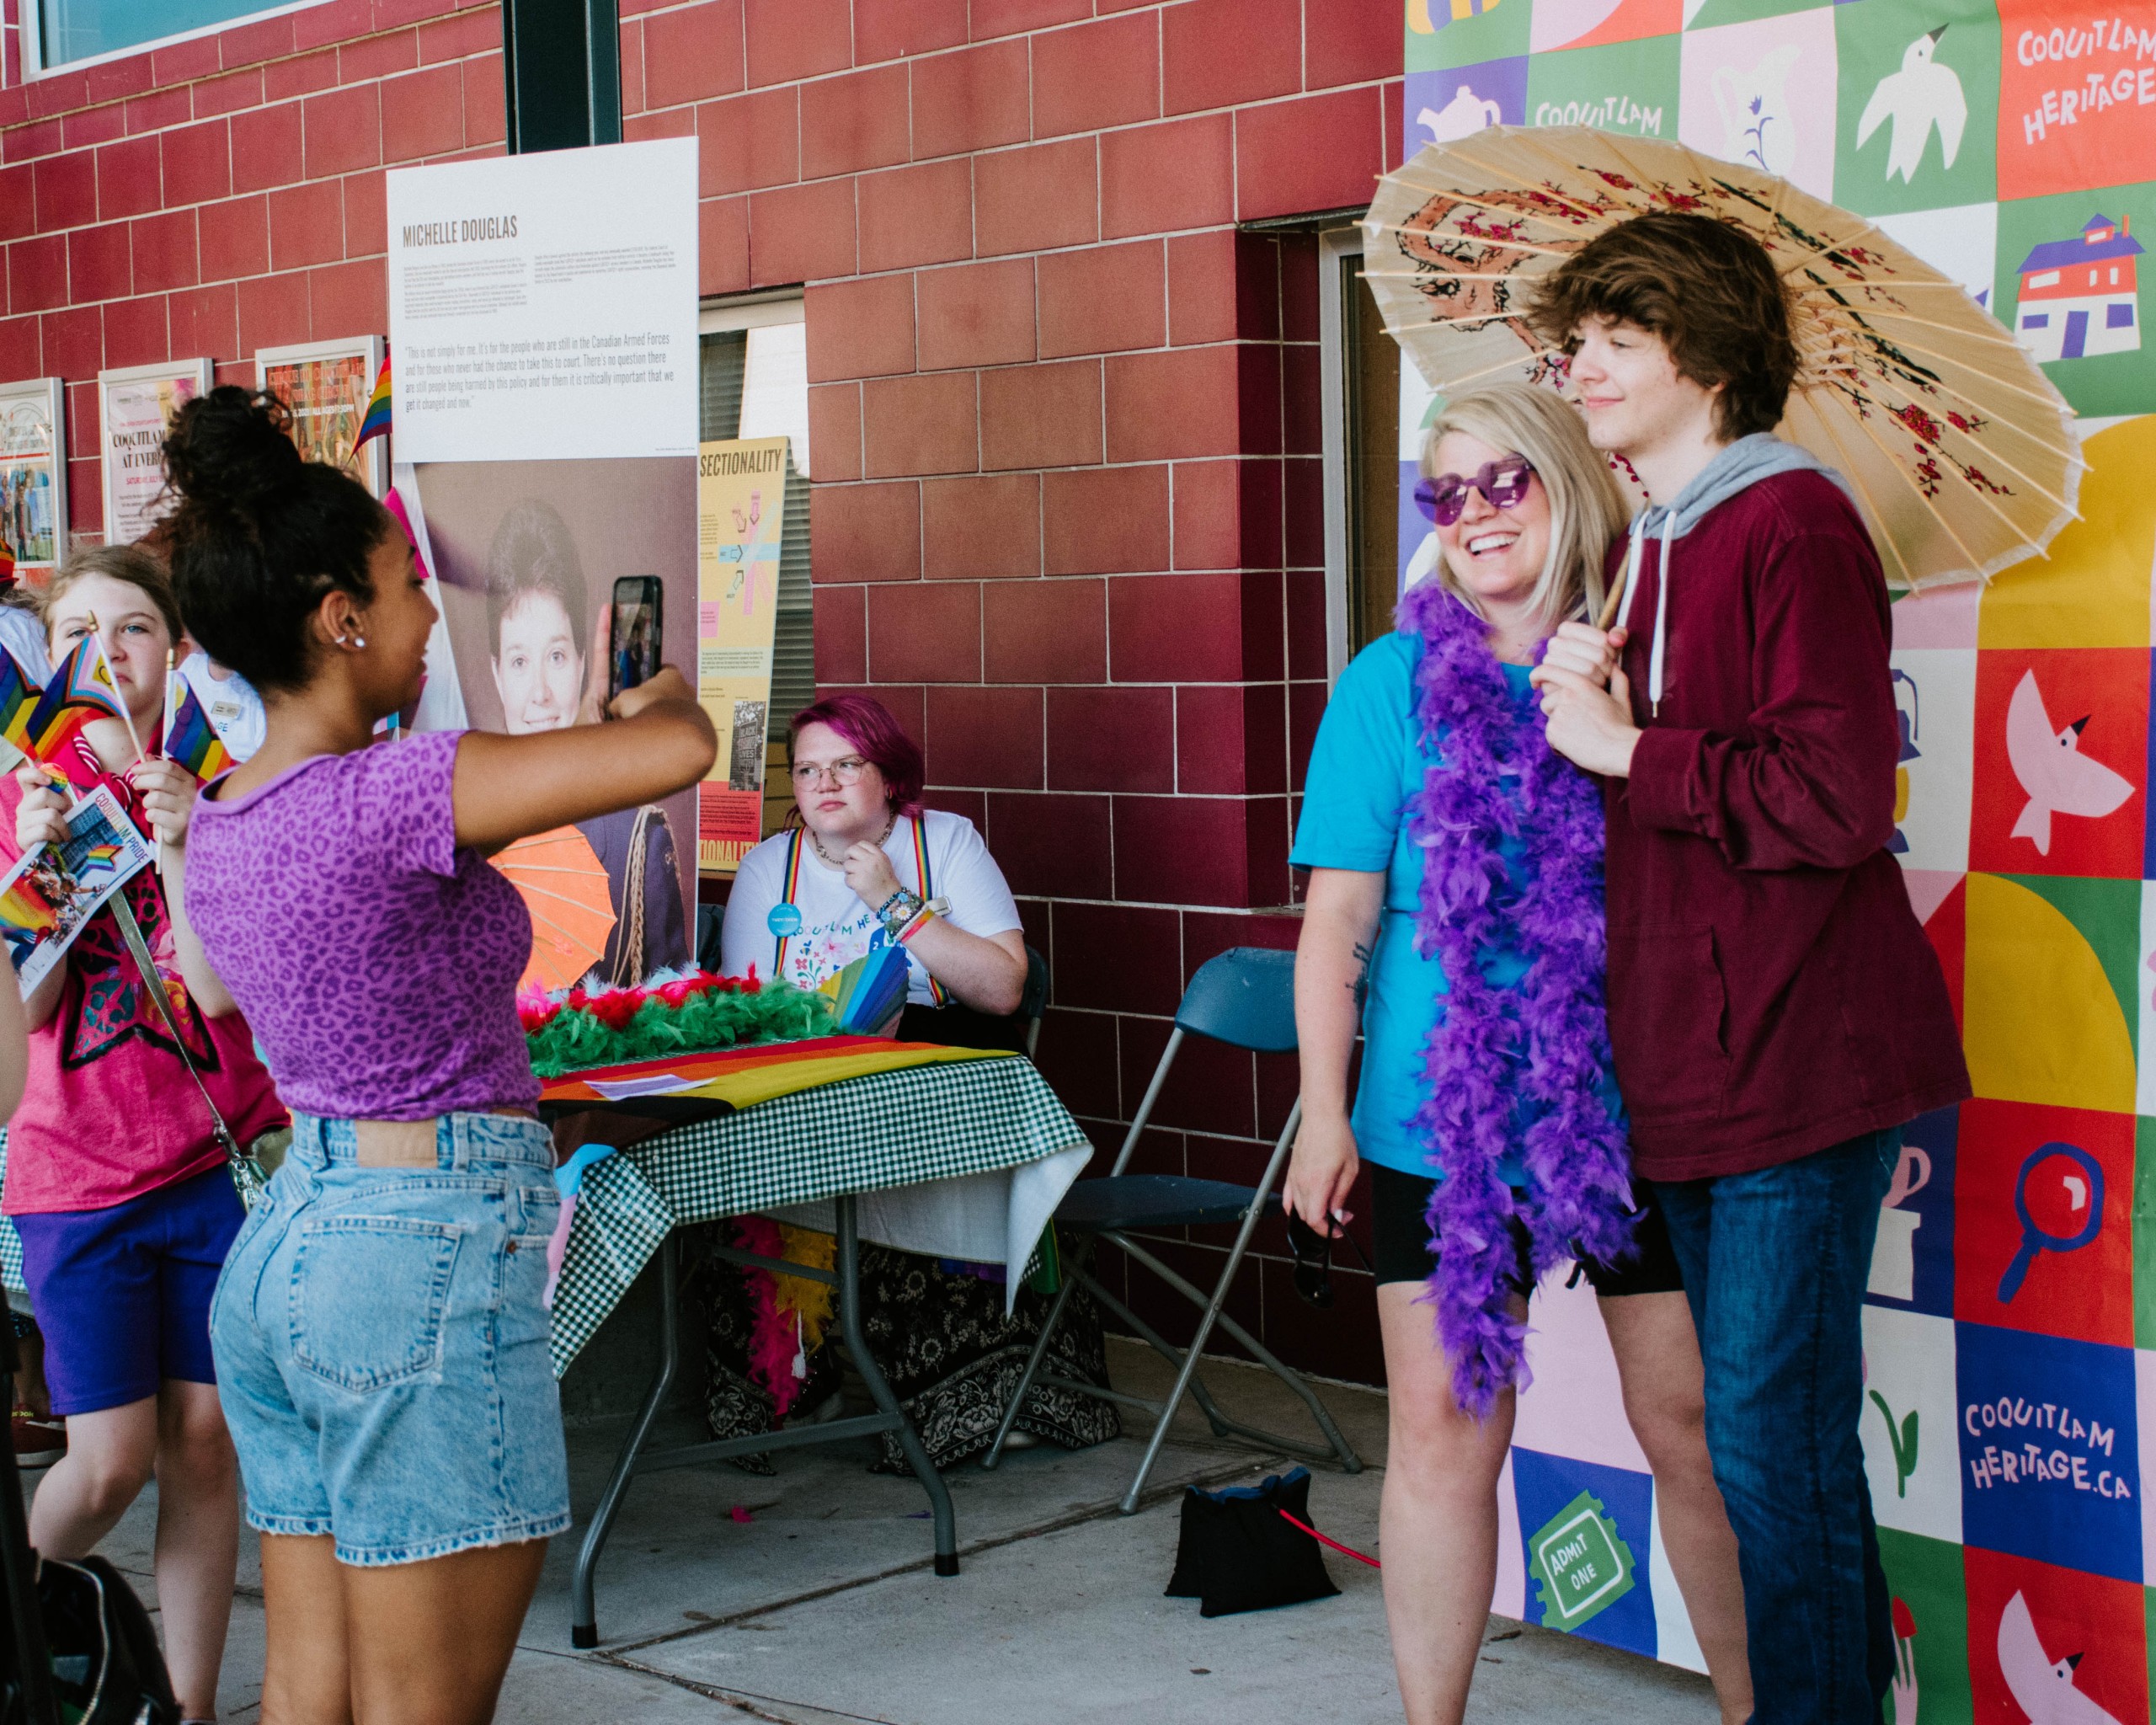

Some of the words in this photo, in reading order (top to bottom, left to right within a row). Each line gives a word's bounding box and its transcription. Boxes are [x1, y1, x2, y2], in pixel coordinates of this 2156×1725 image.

[2017, 17, 2156, 67] COQUITLAM
[1535, 95, 1662, 136] COQUITLAM
[2023, 67, 2156, 146] HERITAGE
[403, 221, 458, 248] MICHELLE
[462, 215, 518, 243] DOUGLAS
[427, 347, 436, 358] not
[437, 345, 456, 358] simply
[500, 340, 510, 353] the
[511, 340, 531, 355] people
[533, 339, 545, 351] who
[547, 341, 557, 351] are
[558, 338, 570, 350] still
[580, 336, 590, 349] the
[592, 334, 622, 349] Canadian
[624, 334, 645, 347] Armed
[648, 332, 670, 345] Forces
[405, 365, 416, 377] and
[427, 363, 441, 376] those
[444, 363, 455, 374] who
[456, 364, 472, 374] never
[473, 360, 483, 372] had
[486, 360, 495, 372] the
[497, 359, 518, 371] chance
[527, 357, 541, 370] take
[542, 356, 553, 370] this
[608, 355, 616, 366] no
[618, 353, 646, 367] question
[648, 351, 666, 364] there
[406, 383, 414, 393] are
[417, 381, 427, 393] still
[428, 381, 447, 394] people
[448, 380, 464, 393] being
[465, 378, 487, 391] harmed
[488, 378, 495, 392] by
[497, 377, 508, 389] this
[510, 376, 527, 391] policy
[529, 376, 540, 388] and
[542, 375, 550, 387] for
[552, 374, 568, 387] them
[584, 371, 612, 387] critically
[613, 371, 646, 387] important
[648, 370, 662, 382] that
[664, 371, 674, 382] we
[406, 399, 415, 413] get
[423, 398, 446, 412] changed
[447, 397, 457, 409] and
[122, 455, 132, 469] AT
[700, 448, 782, 478] SECTIONALITY
[126, 836, 149, 863] PRIDE
[1966, 1397, 2115, 1457] COQUITLAM
[1971, 1443, 2132, 1500] HERITAGE.CA
[1550, 1533, 1588, 1577] ADMIT
[1571, 1562, 1598, 1591] ONE
